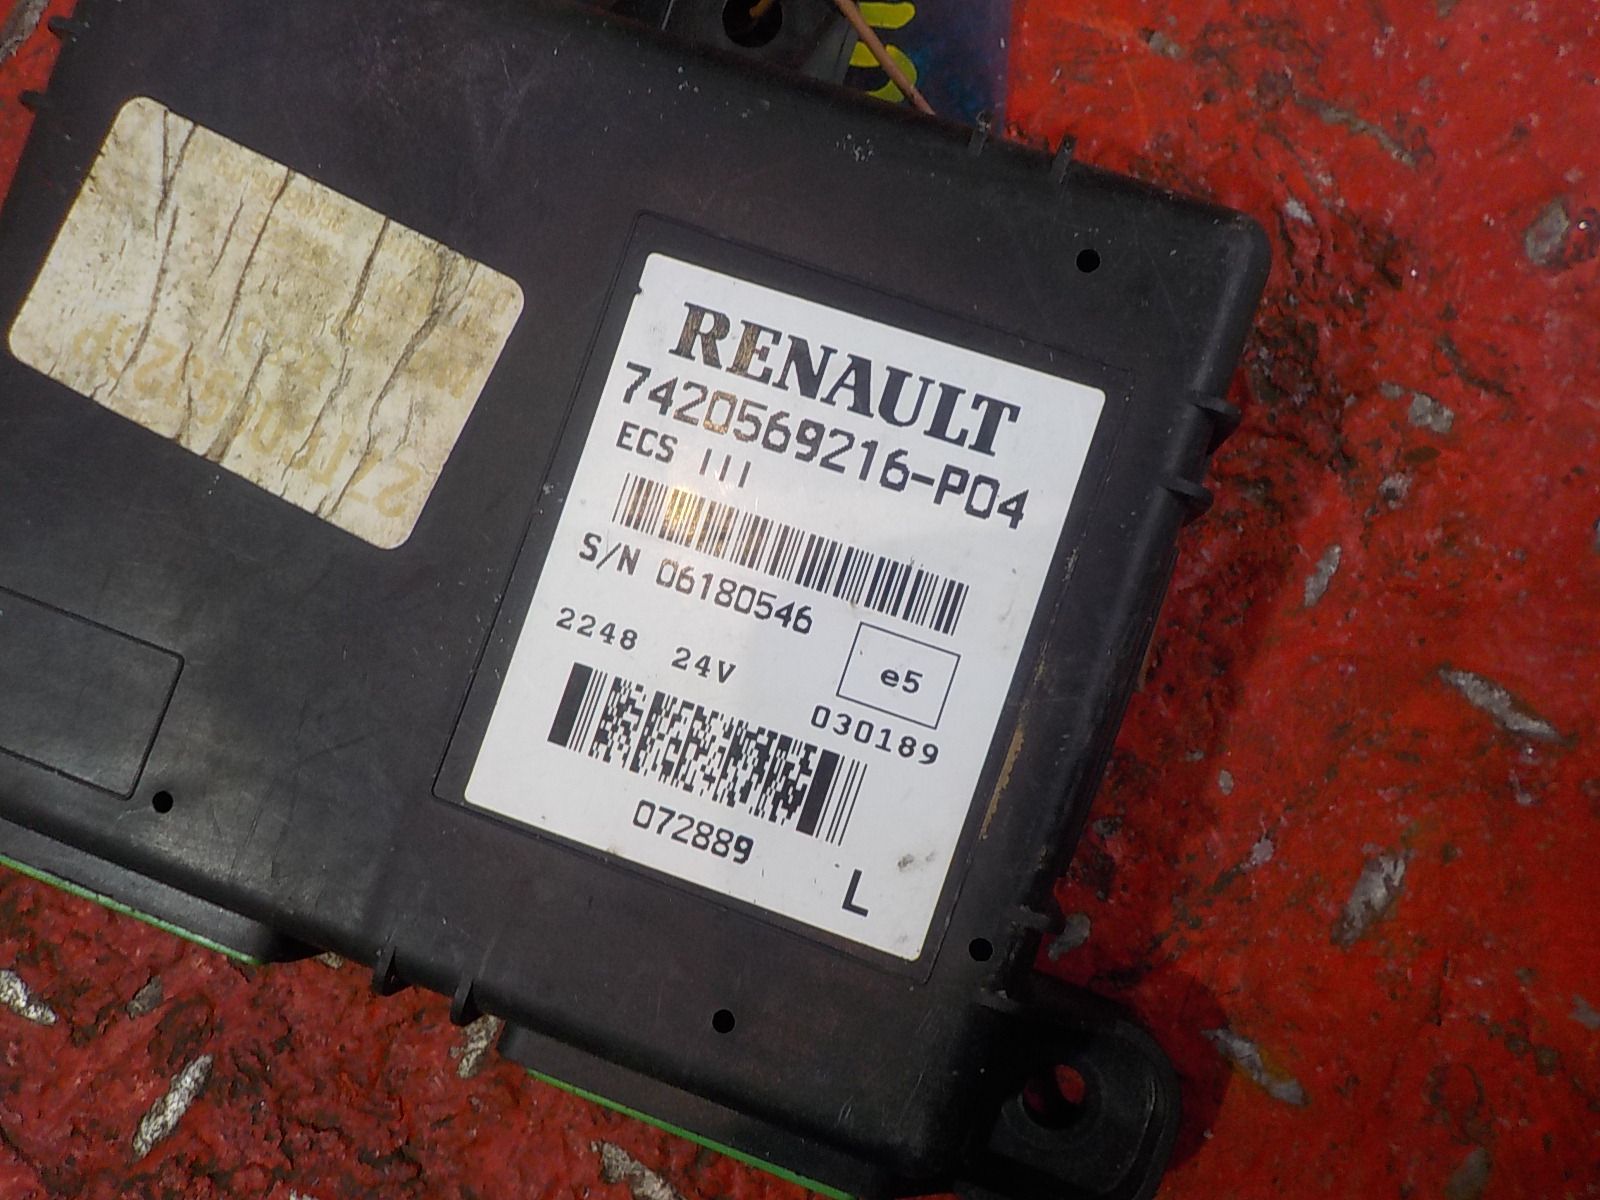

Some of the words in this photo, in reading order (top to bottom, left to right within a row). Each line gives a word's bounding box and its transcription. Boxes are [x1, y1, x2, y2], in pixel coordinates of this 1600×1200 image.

[669, 302, 1021, 456] RENAULT
[617, 422, 677, 463] ECS
[624, 362, 1029, 529] 7420569216-P04
[579, 532, 640, 575] S/N
[656, 559, 812, 634] 06180546
[556, 607, 637, 650] 2248
[672, 647, 736, 683] 24V
[881, 669, 923, 693] e5
[811, 705, 938, 764] 030189
[633, 800, 754, 864] 072889
[842, 869, 868, 917] L
